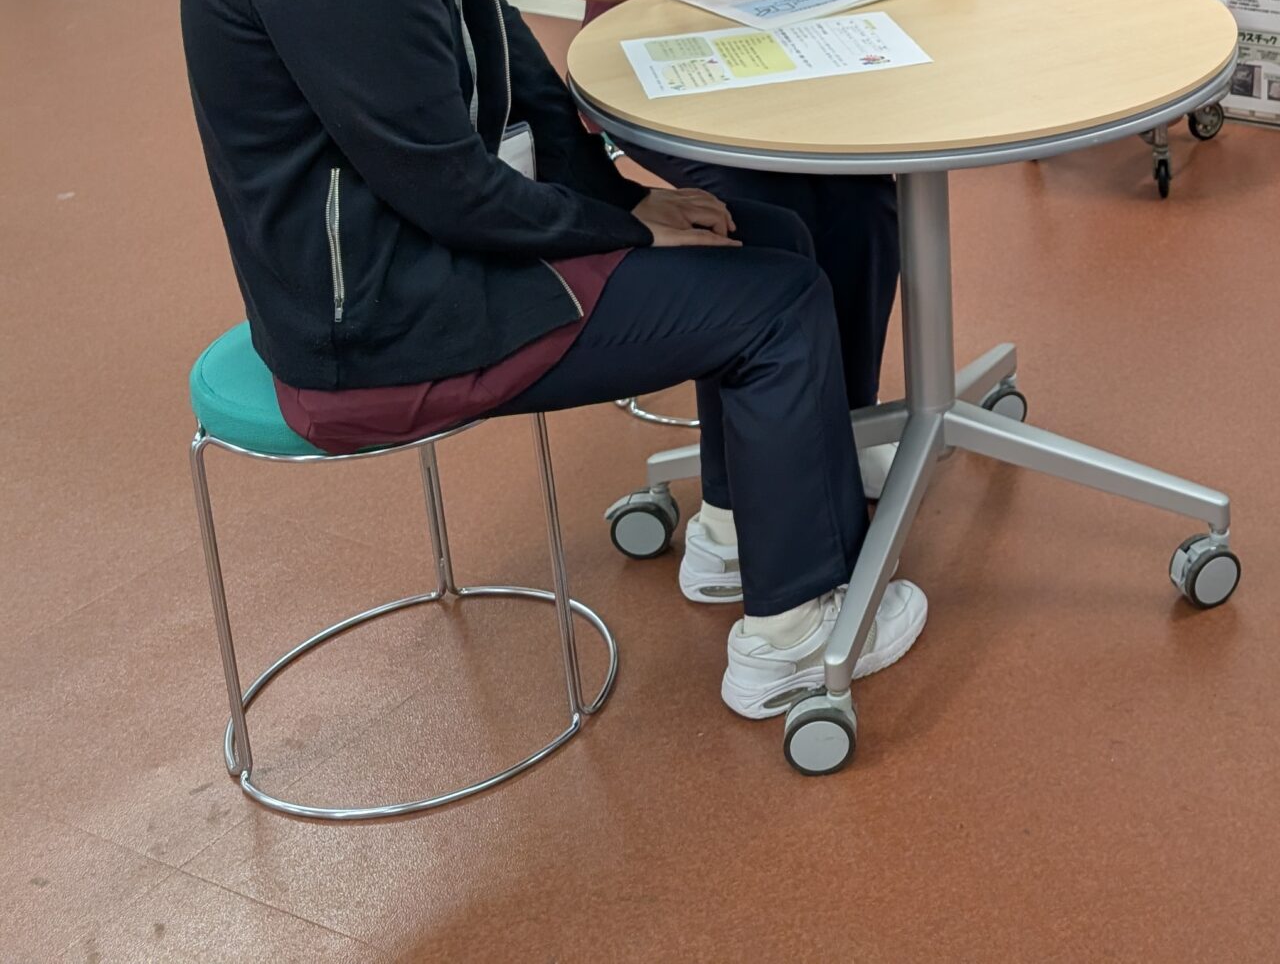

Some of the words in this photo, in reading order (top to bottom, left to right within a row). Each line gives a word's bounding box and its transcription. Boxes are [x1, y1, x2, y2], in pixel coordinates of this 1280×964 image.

[1238, 31, 1278, 45] ラスチック
